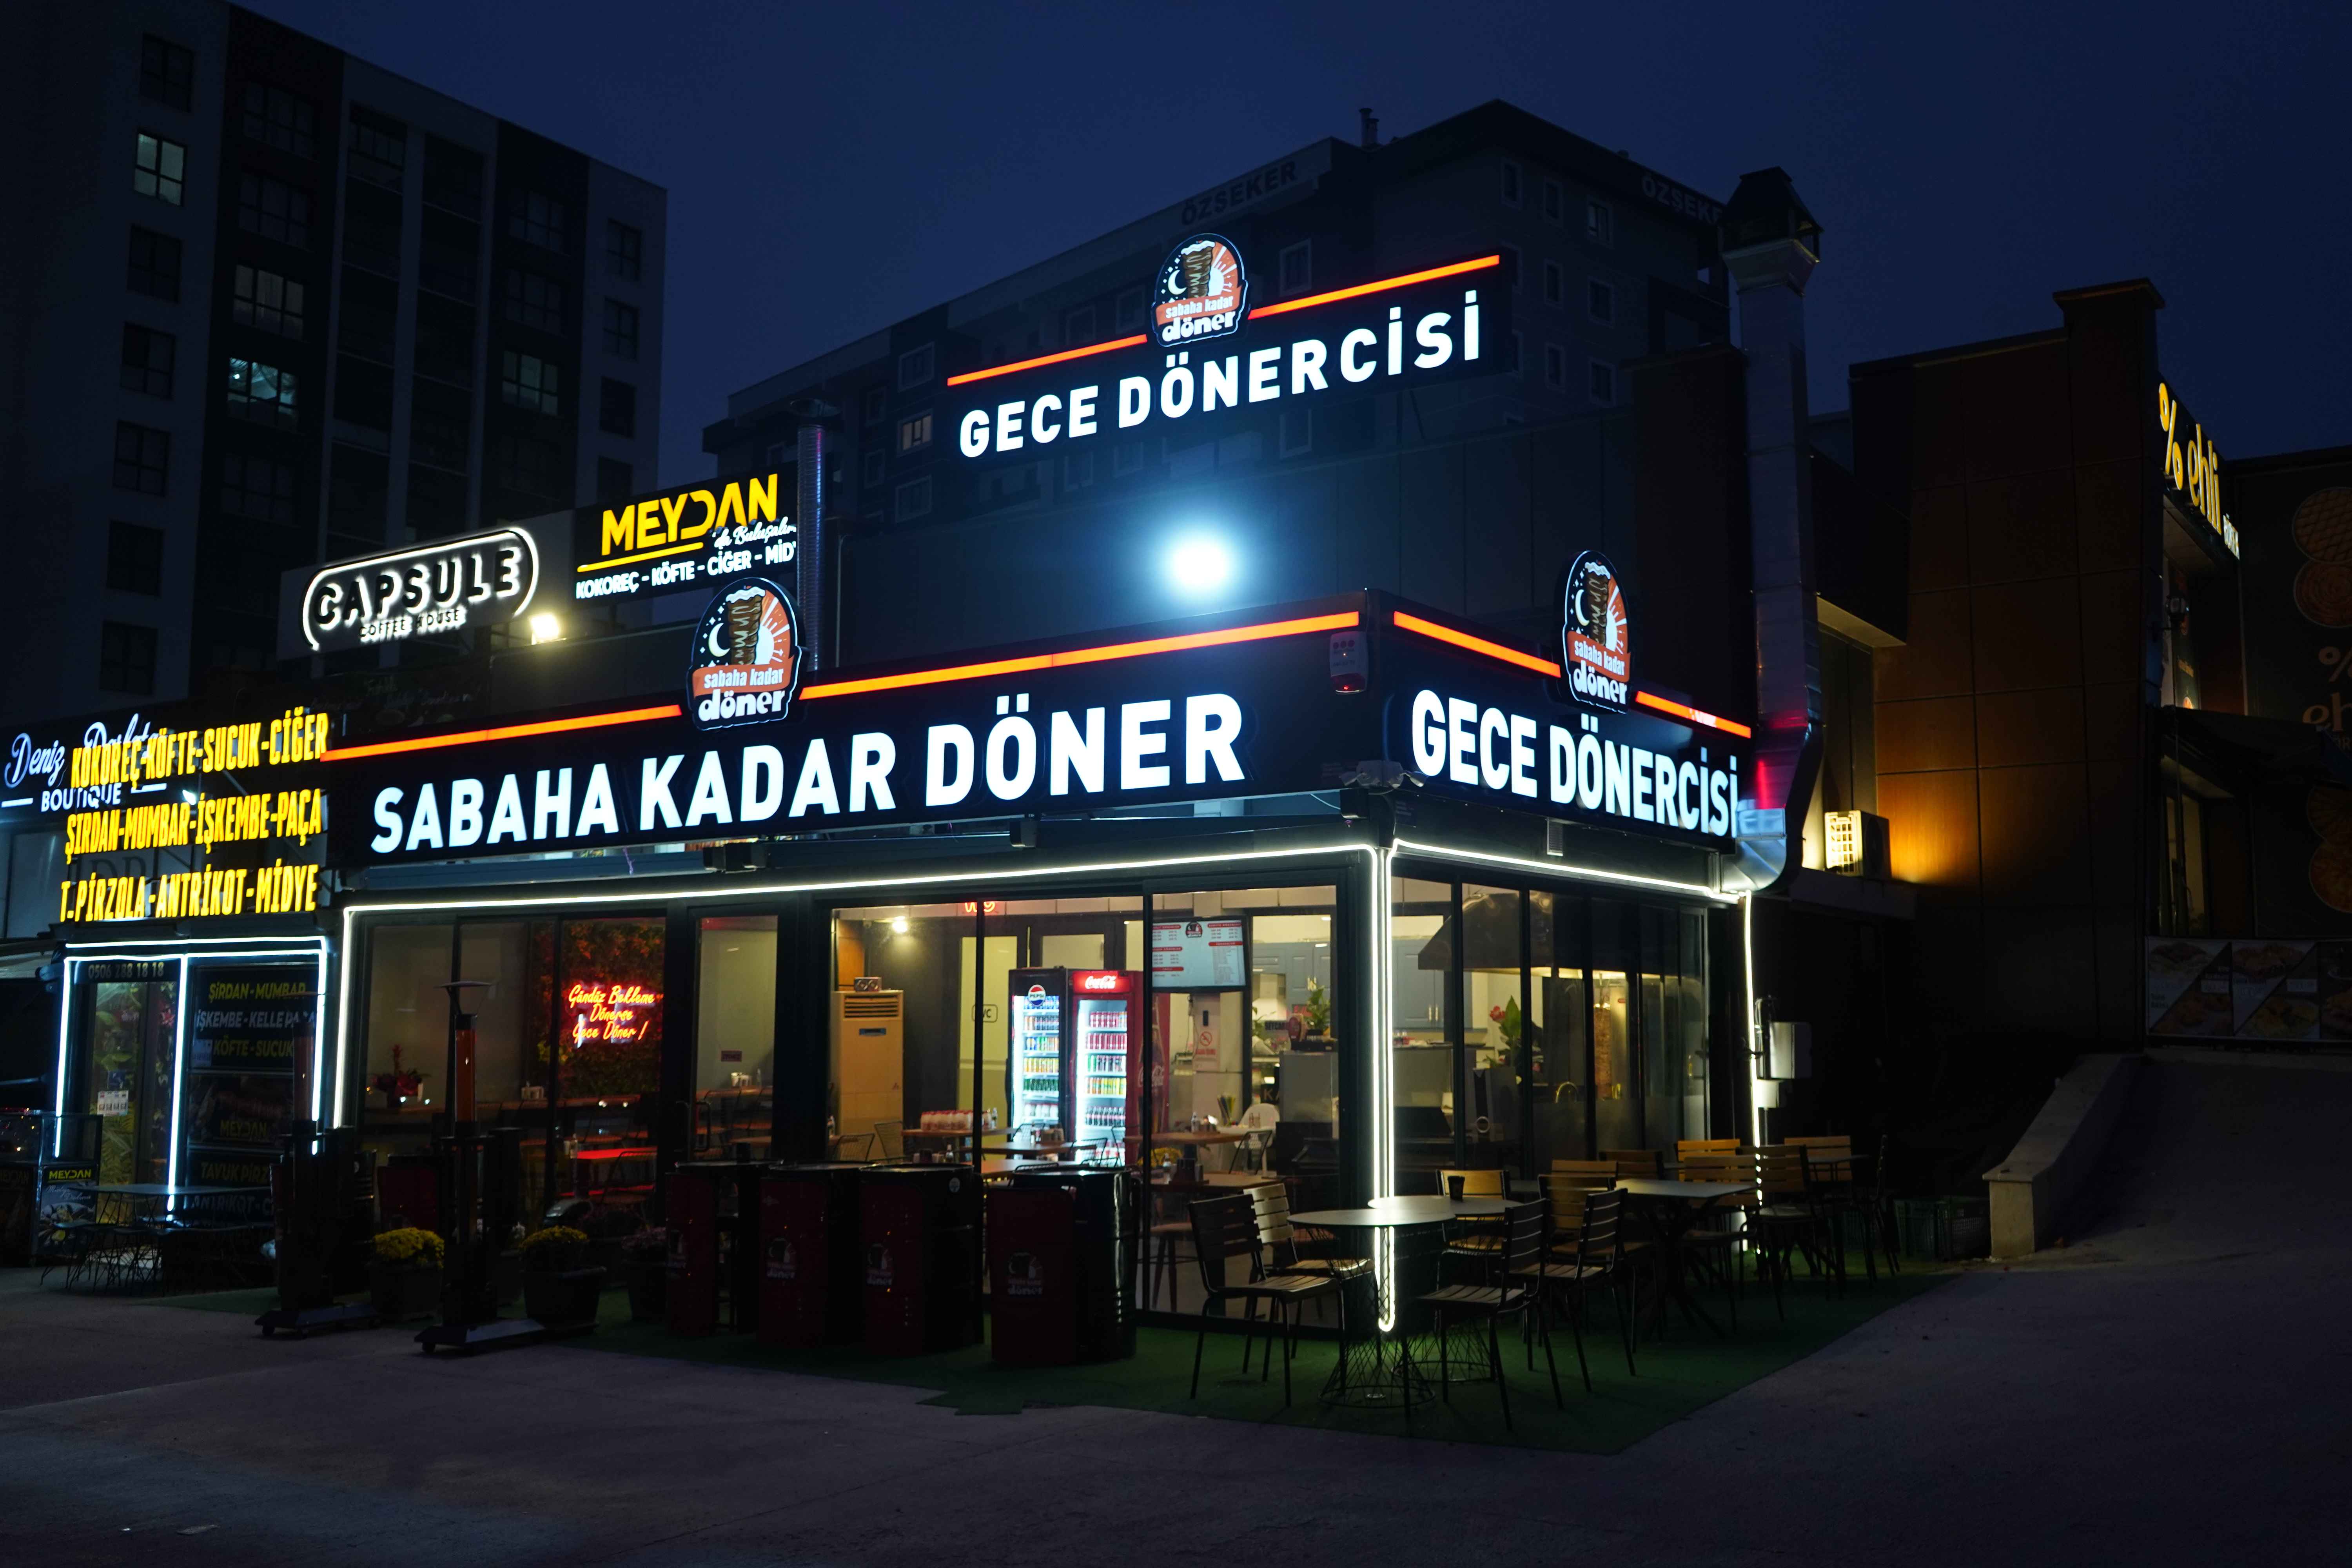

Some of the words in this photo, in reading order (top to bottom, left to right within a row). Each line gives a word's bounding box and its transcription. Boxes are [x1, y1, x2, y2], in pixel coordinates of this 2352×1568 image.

[1165, 301, 1202, 318] sabaha
[1205, 296, 1234, 312] kadar
[1162, 311, 1236, 342] döner
[960, 385, 1098, 458] GECE
[1118, 289, 1479, 428] DÖNERCİSİ
[602, 474, 778, 556] MEYDAN
[315, 548, 519, 629] CAPSULE
[576, 572, 640, 599] KOKOREÇ
[652, 561, 695, 586] KÖFTE
[707, 549, 752, 575] CİĞER
[359, 617, 411, 641] COFFEE
[416, 607, 465, 632] HOUSE
[1574, 640, 1602, 666] sabaha
[1604, 651, 1625, 676] kadar
[704, 668, 747, 689] sabaha
[750, 666, 784, 686] kadar
[1573, 660, 1627, 704] döner
[698, 689, 785, 722] döner
[4, 732, 66, 788] Deniz
[370, 763, 619, 853] SABAHA
[640, 732, 897, 831] KADAR
[926, 693, 1245, 806] DÖNER
[1412, 690, 1537, 798] GECE
[1550, 713, 1737, 838] DÖNERCİSİ
[41, 782, 122, 812] BOUTIQUE
[136, 962, 149, 978] 18
[152, 961, 165, 978] 18
[568, 984, 606, 1009] Gündüz
[608, 985, 655, 1004] Bekleme
[590, 1003, 634, 1022] Dönerse
[572, 1020, 599, 1044] Gece
[603, 1020, 637, 1040] Döner
[48, 1169, 92, 1181] MEYDAN
